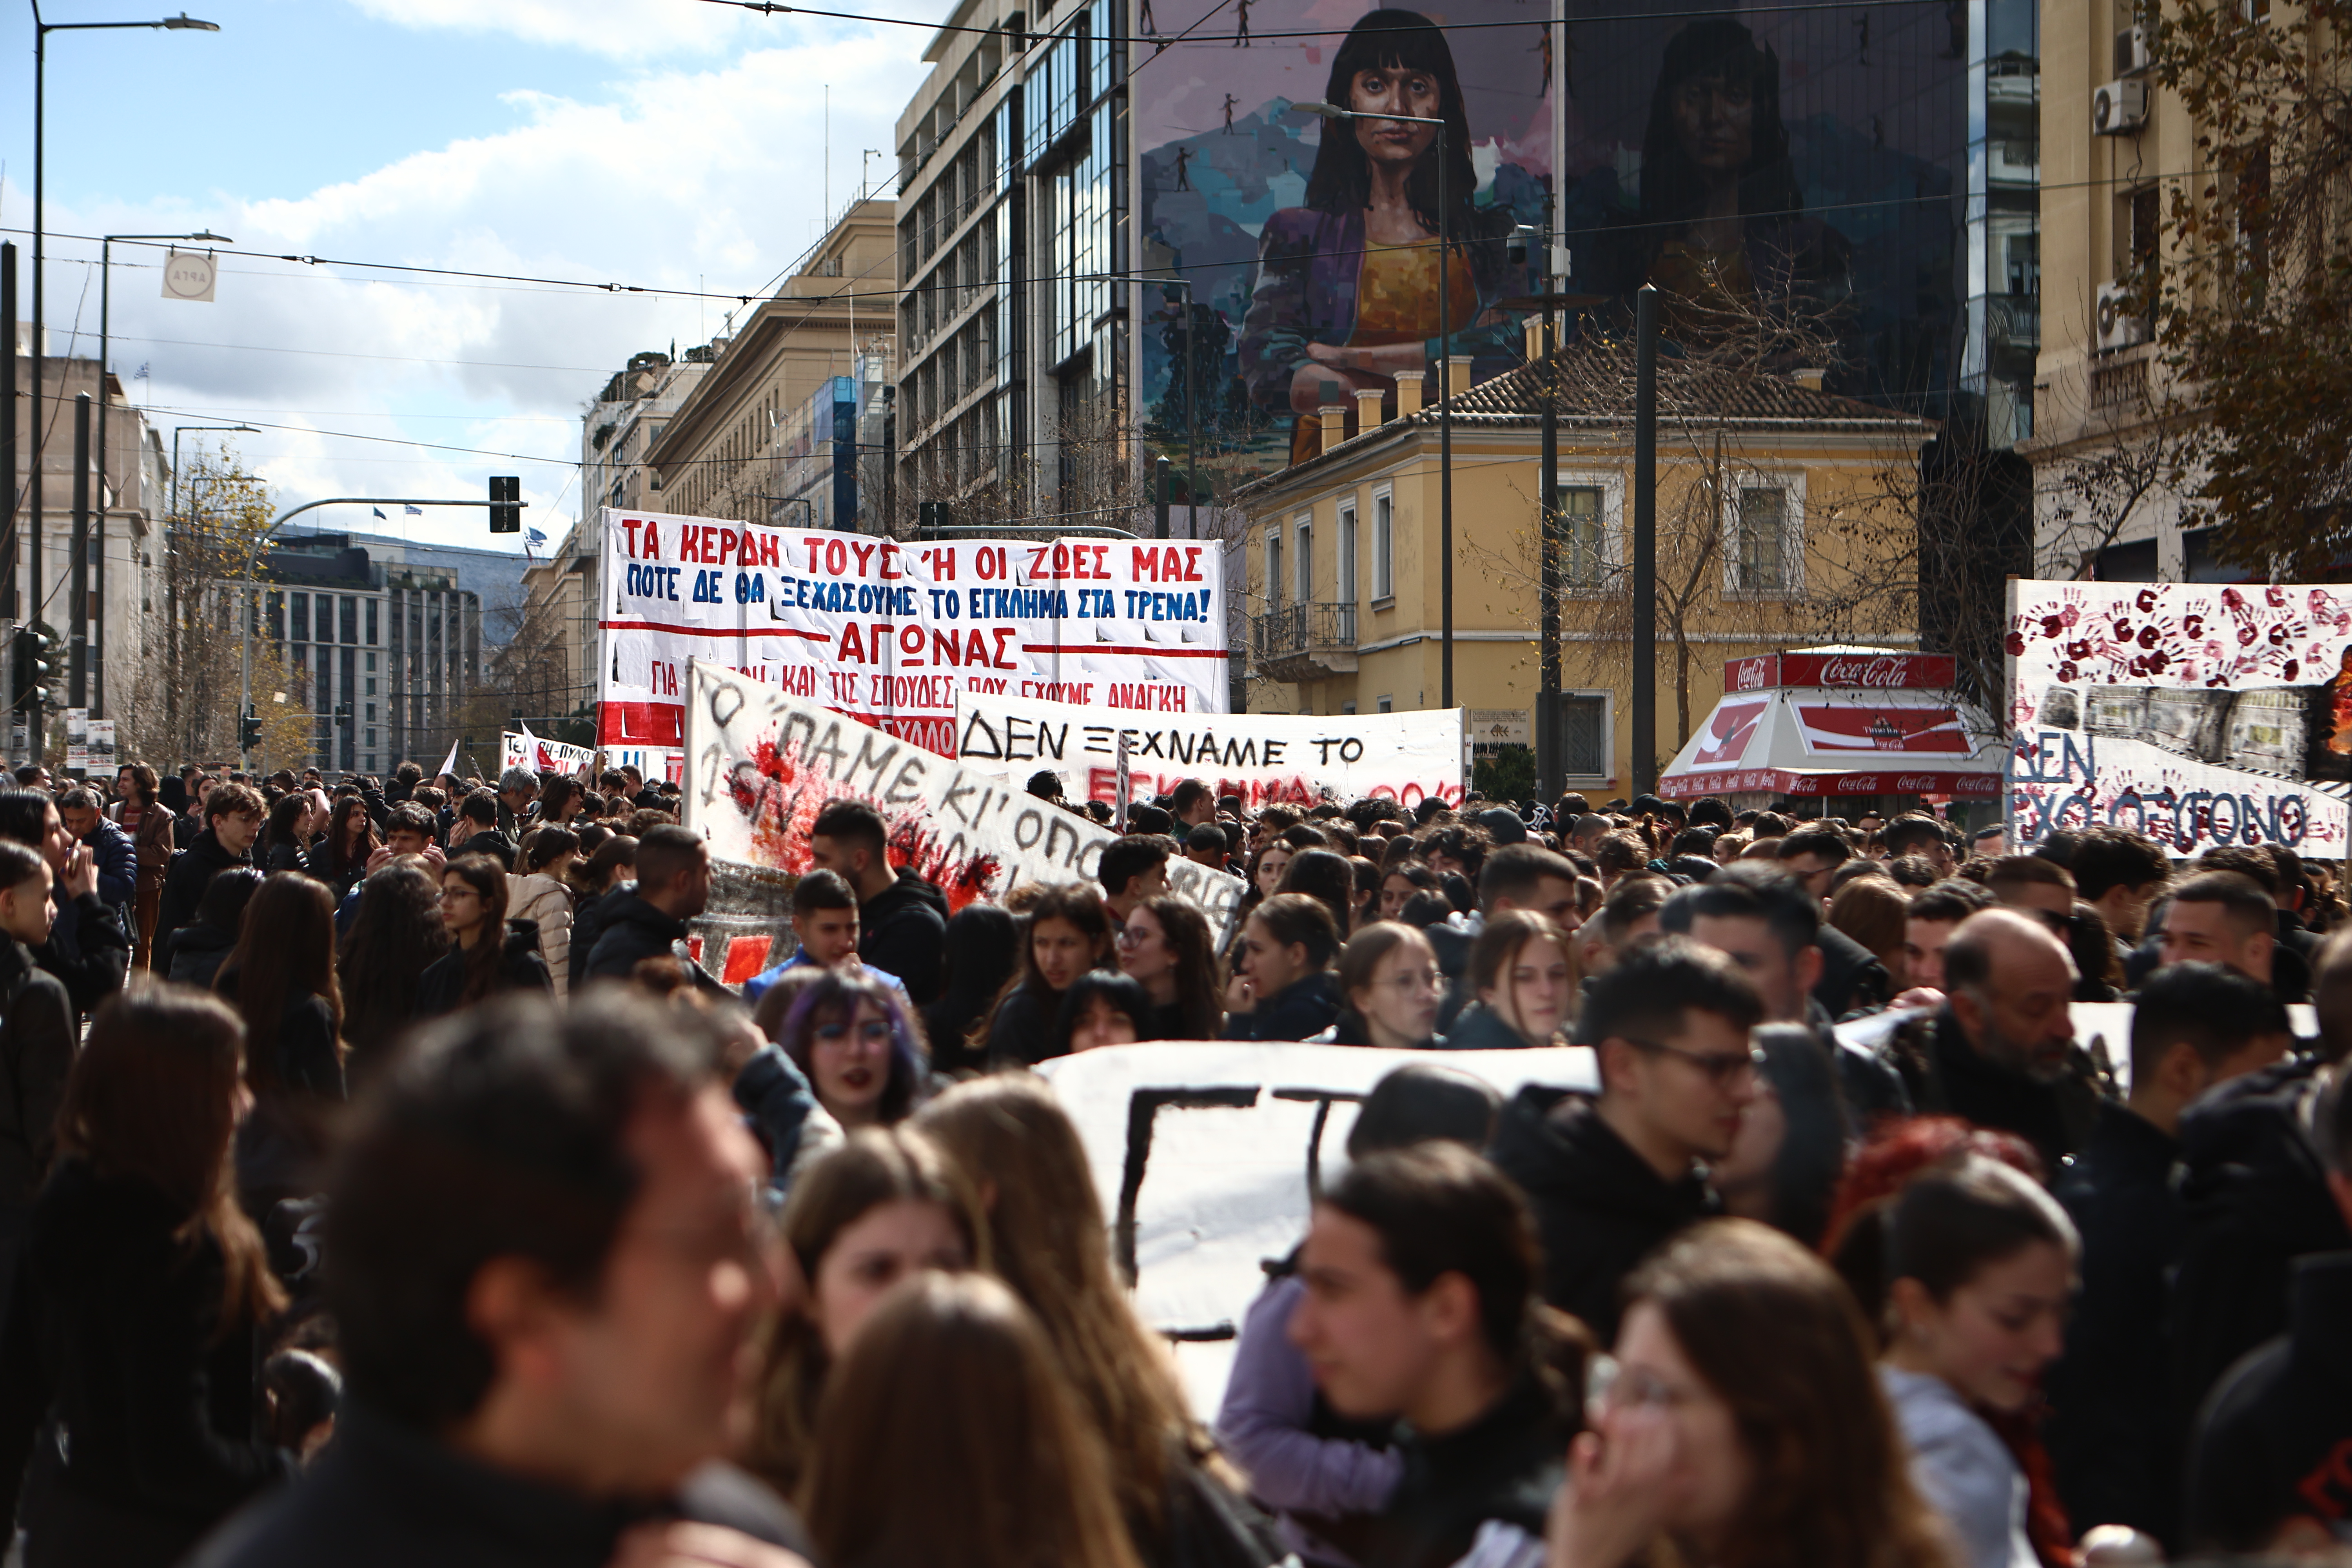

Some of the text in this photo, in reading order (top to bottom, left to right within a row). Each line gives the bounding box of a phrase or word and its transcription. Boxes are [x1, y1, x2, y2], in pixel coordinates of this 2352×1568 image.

[622, 519, 659, 560] ΤΑ
[680, 524, 780, 568] ΚΕΡΔΗ
[803, 537, 902, 580] ΤΟΥΣ
[975, 546, 1007, 580] ΟΙ
[1027, 544, 1111, 580] ΖΩΕΣ
[1132, 546, 1203, 582] ΜΑΣ
[627, 563, 1211, 623] ΠΟΤΕ ΔΕ ΘΑ ΞΕΧΑΣΟΥΜΕ ΤΟ ΕΓΚΛΗΜΑ ΣΤΑ ΤΡΕΝΑ!
[837, 622, 1017, 670] ΑΓΩΝΑΣ
[652, 661, 679, 697] ΓΙΑ
[782, 665, 815, 697] ΚΑΙ
[828, 671, 859, 704] ΤΙΣ
[870, 673, 954, 709] ΣΠΟΥΔΕΣ
[1108, 683, 1185, 713] ΑΝΑΓΚΗ
[879, 719, 955, 755] ΣΥΛΛΟ
[960, 709, 1068, 762] ΔΕΝ
[1083, 726, 1288, 767] ΞΕΧΝΑΜΕ
[1310, 737, 1364, 766] ΤΟ
[2003, 731, 2096, 784] ΔΕΝ
[1087, 767, 1315, 809] ΕΓΚΗΜΑ
[1014, 809, 1102, 882] ΟΠΟ
